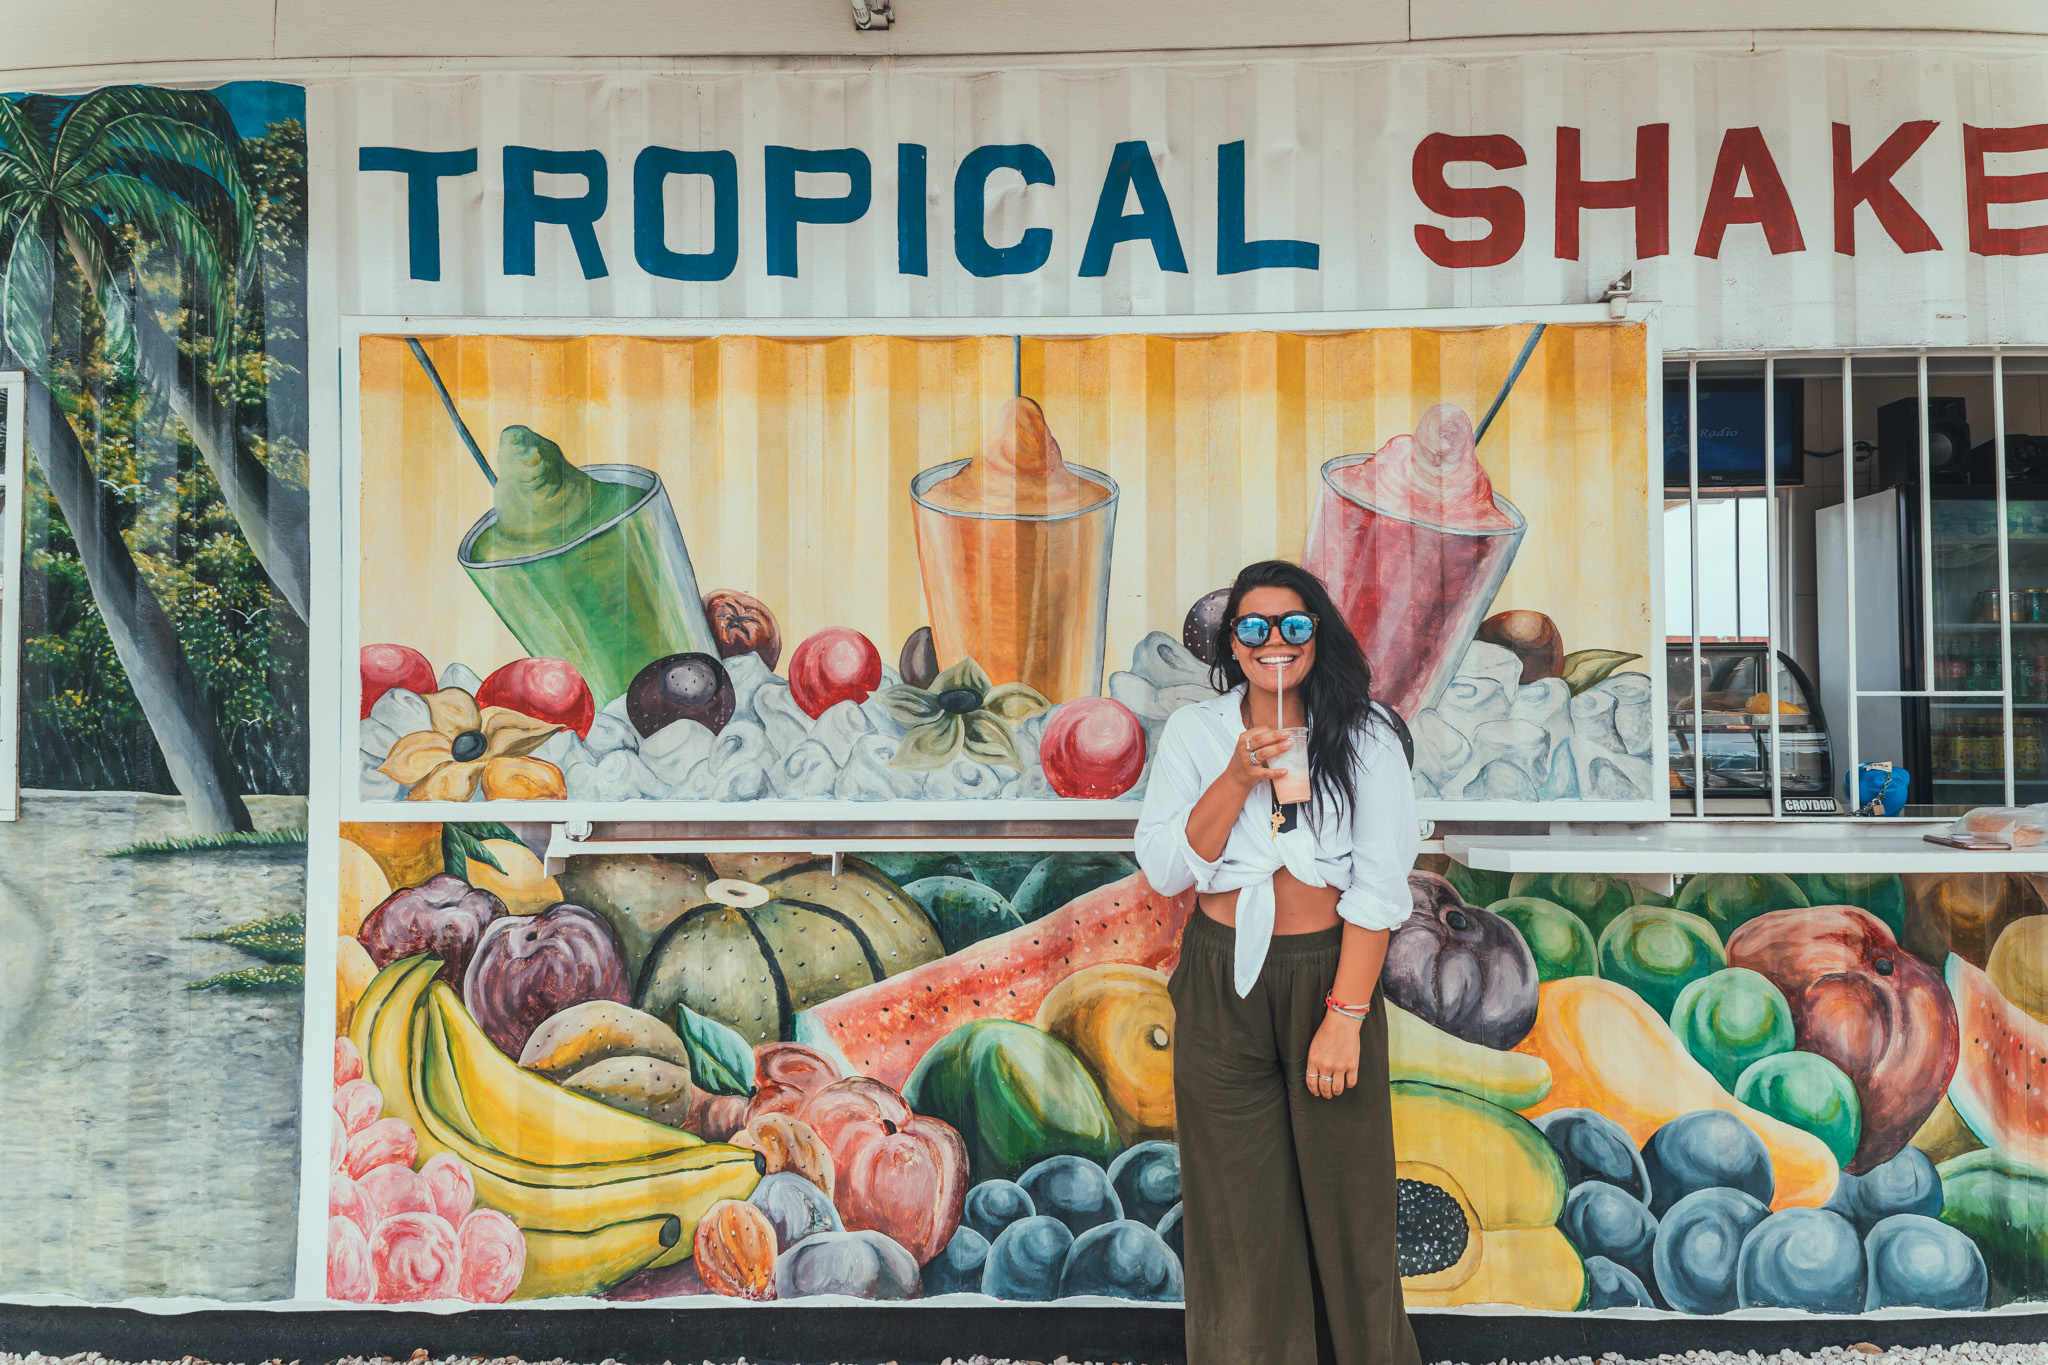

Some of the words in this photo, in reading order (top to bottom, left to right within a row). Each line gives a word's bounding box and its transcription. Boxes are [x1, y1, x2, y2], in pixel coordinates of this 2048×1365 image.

[360, 141, 1319, 281] TROPICAL
[1413, 120, 2048, 268] SHAKE
[1698, 427, 1738, 439] Radio
[1785, 799, 1836, 811] CROYDON
